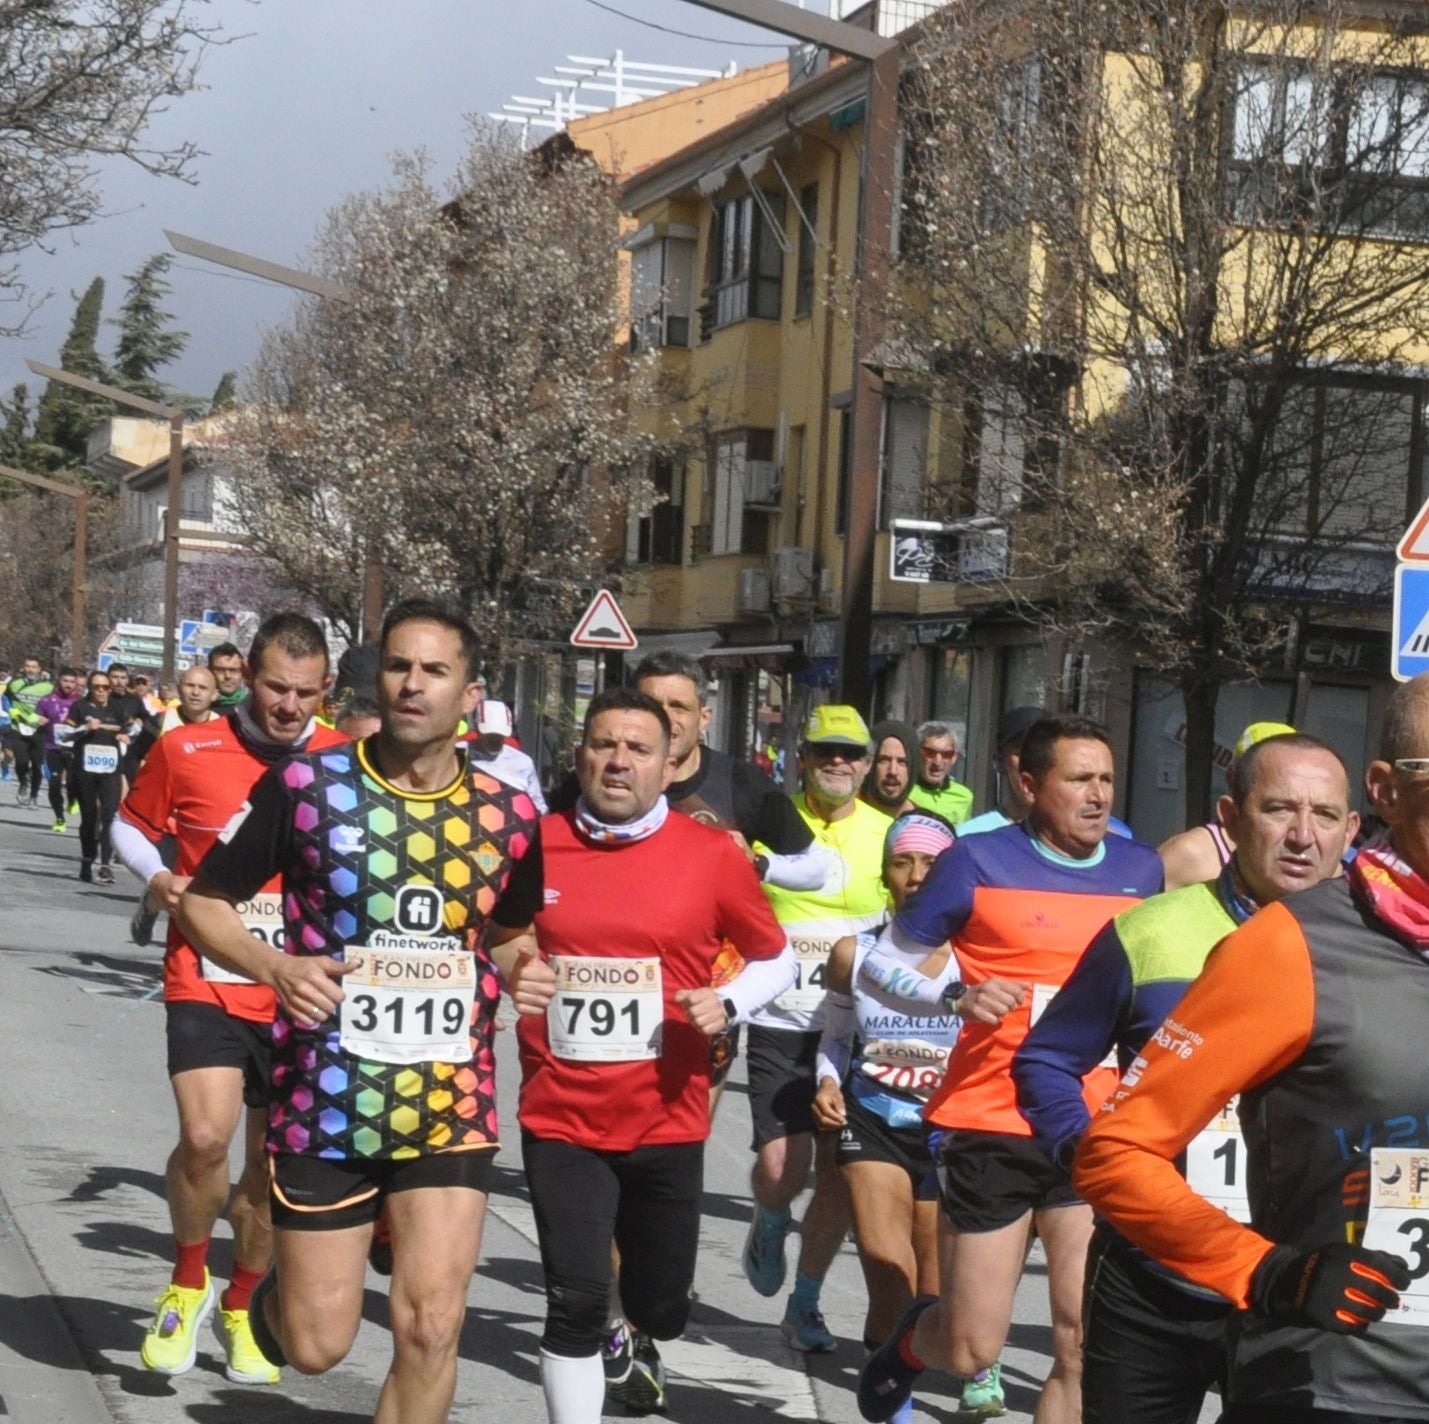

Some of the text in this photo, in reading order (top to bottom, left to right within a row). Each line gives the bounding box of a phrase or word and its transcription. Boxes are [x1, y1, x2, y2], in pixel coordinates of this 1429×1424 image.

[87, 756, 115, 768] 3090
[375, 934, 457, 951] finetwork
[374, 960, 452, 979] FONDO
[568, 967, 639, 984] FONDO
[351, 994, 465, 1035] 3119
[562, 998, 640, 1036] 791
[864, 1015, 961, 1029] MARACENA
